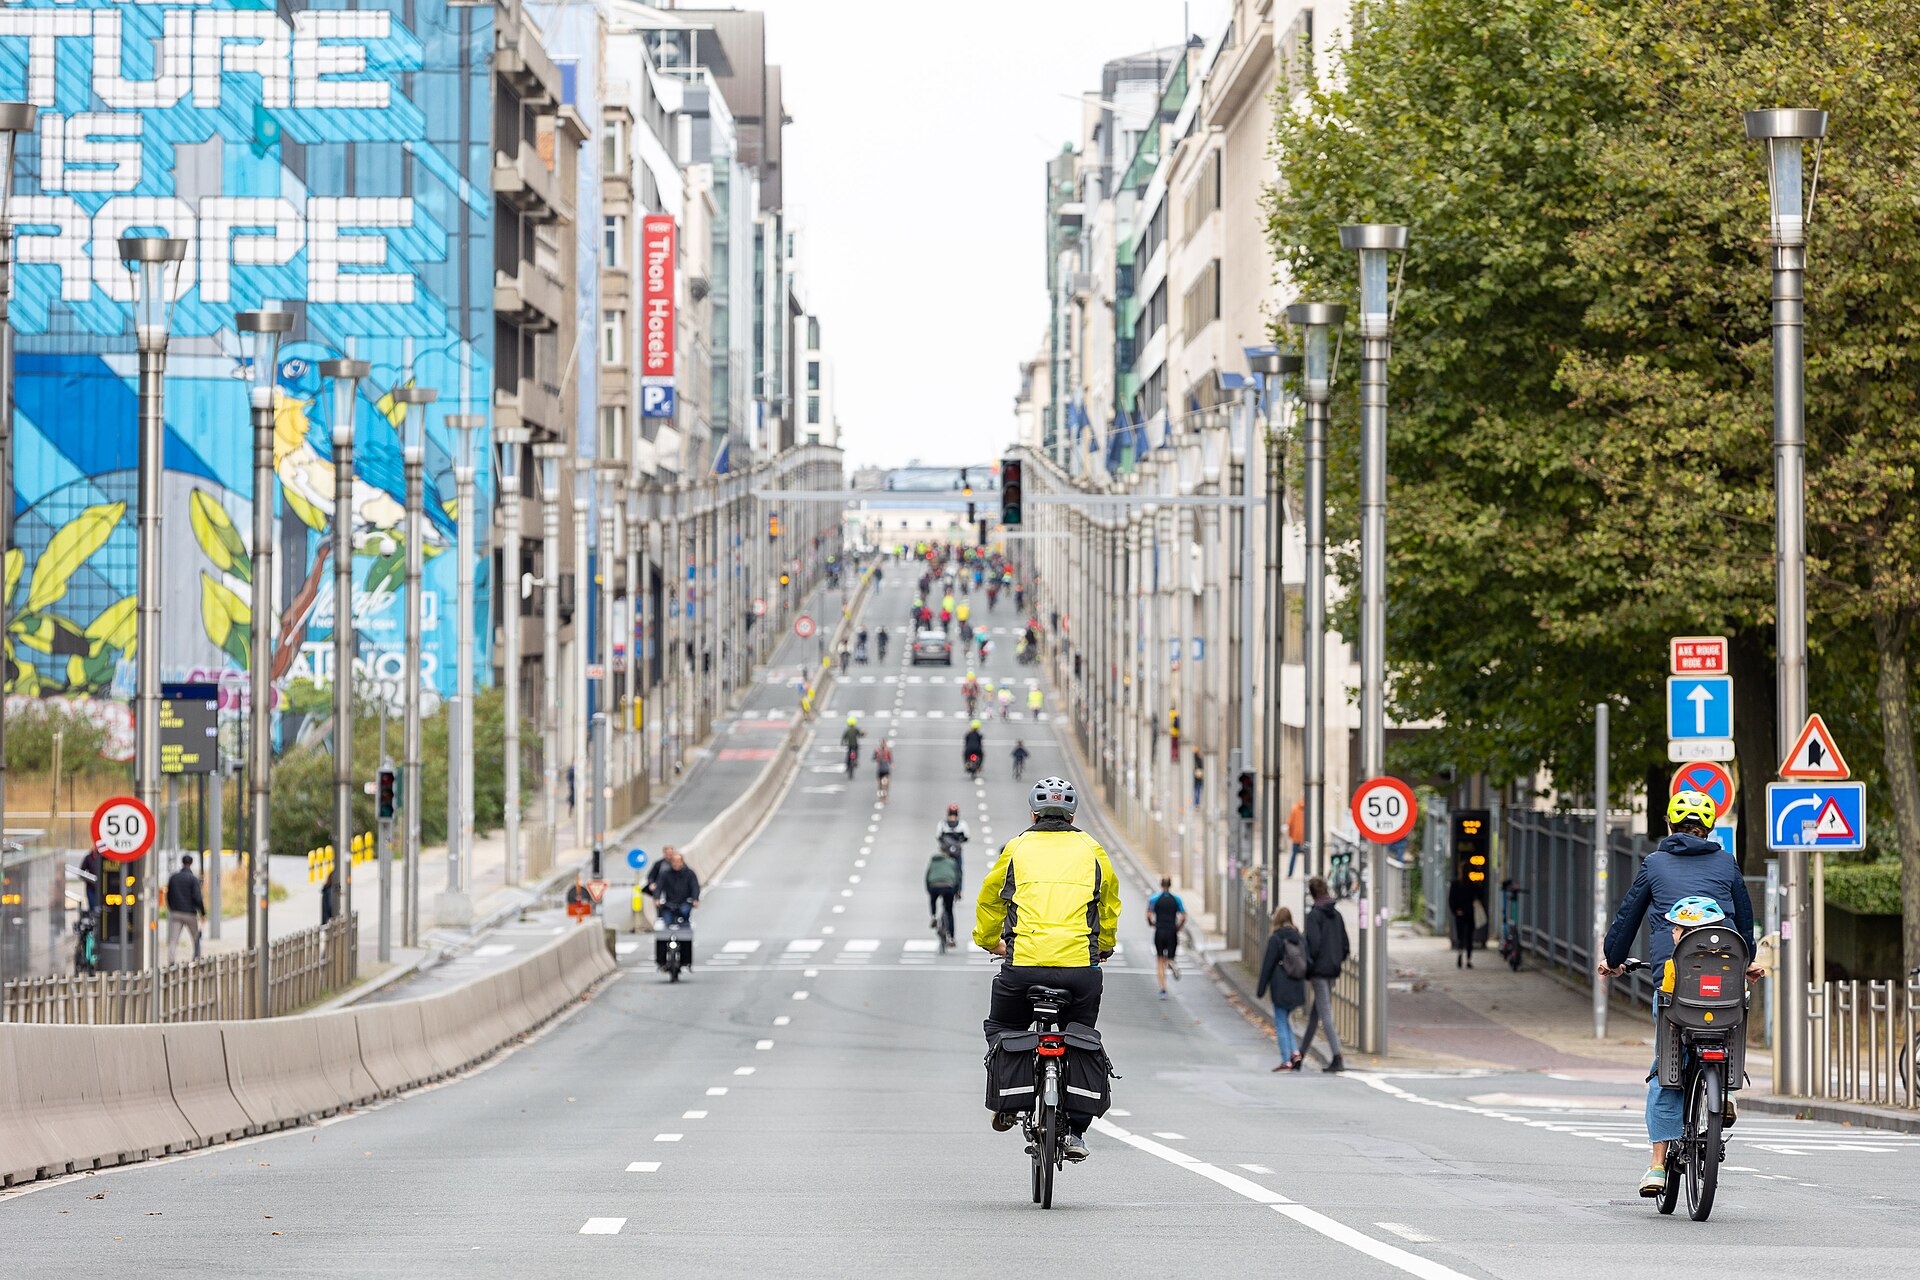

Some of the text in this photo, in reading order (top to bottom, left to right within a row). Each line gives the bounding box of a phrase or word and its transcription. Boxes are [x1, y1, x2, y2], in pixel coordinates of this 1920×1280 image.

[41, 112, 143, 192] IS
[648, 237, 670, 292] Thon
[648, 299, 670, 368] Hotels
[1677, 645, 1720, 656] AXE ROUGE
[1705, 657, 1717, 668] AS
[1368, 796, 1400, 817] 50
[107, 815, 139, 836] 50
[1376, 820, 1394, 829] km
[114, 838, 132, 848] km
